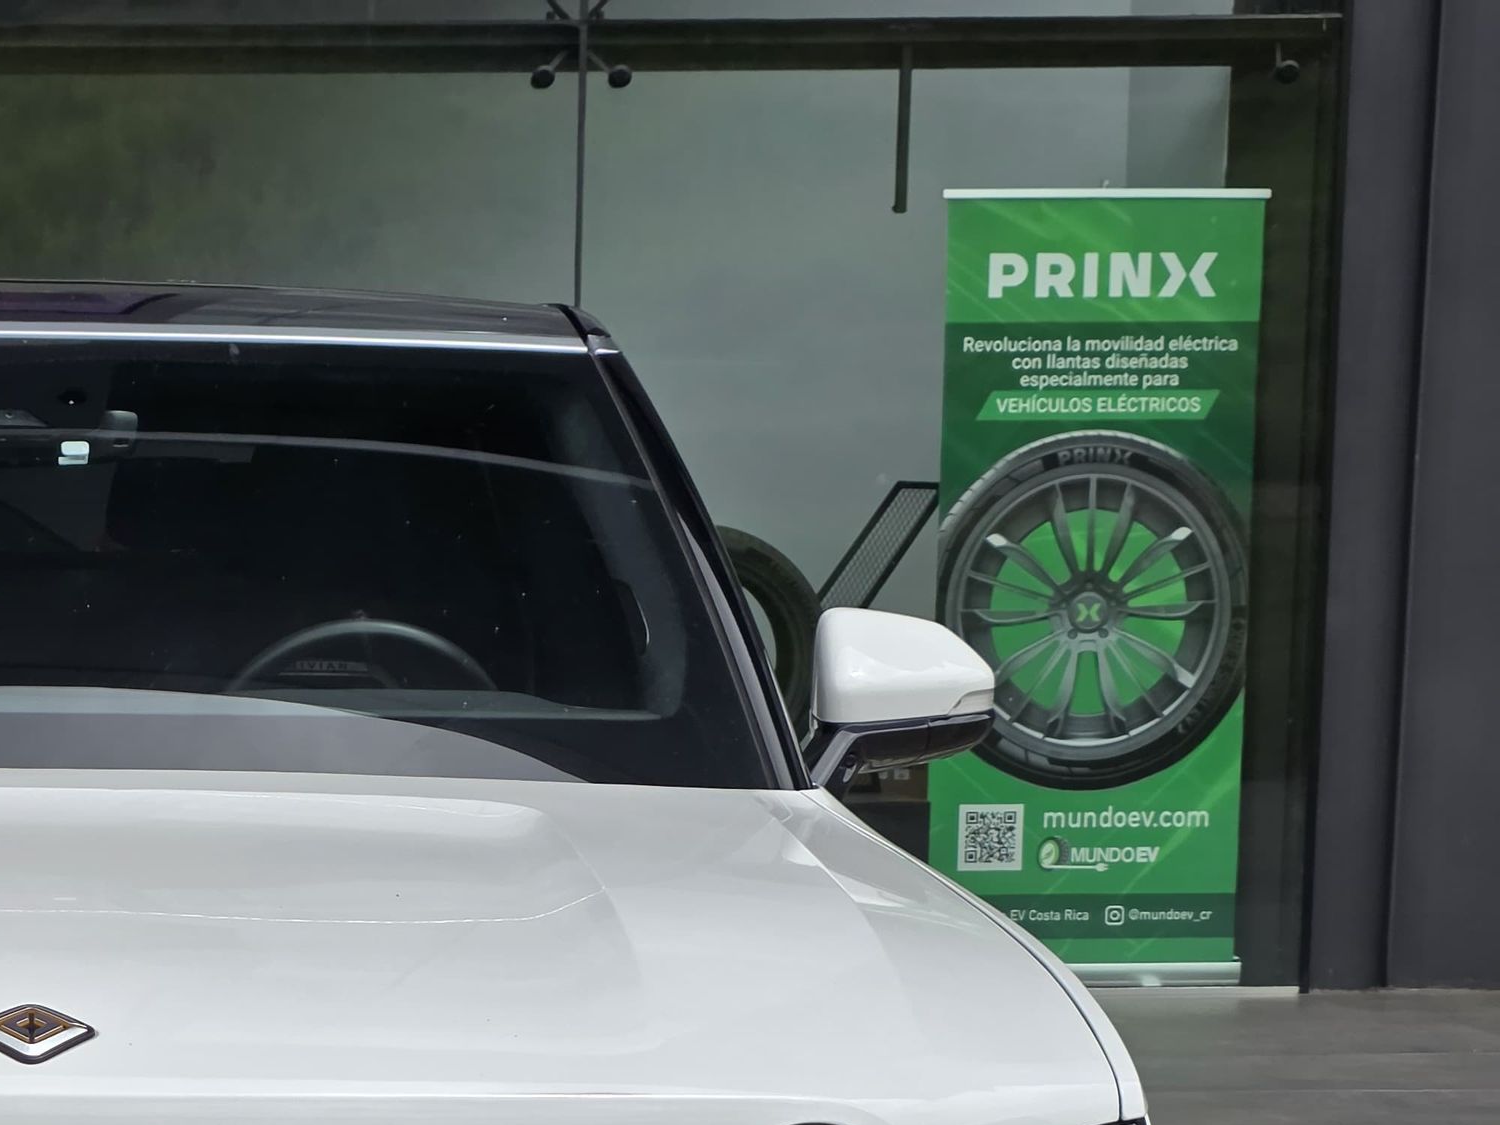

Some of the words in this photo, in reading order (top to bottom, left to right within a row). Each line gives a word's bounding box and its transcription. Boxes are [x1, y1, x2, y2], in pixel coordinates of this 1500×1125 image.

[988, 252, 1218, 298] PRINX
[963, 336, 1062, 352] Revoluciona
[1066, 335, 1081, 351] la
[1085, 335, 1165, 351] movilidad
[1168, 335, 1239, 351] eléctrica
[1011, 357, 1042, 369] con
[1046, 353, 1101, 369] llantas
[1105, 352, 1189, 369] diseñadas
[1019, 371, 1139, 390] especialmente
[1142, 374, 1180, 390] para
[996, 394, 1092, 413] VEHÍCULOS
[1096, 394, 1202, 413] ELÉCTRICOS
[1043, 805, 1209, 829] mundoev.com
[1070, 846, 1160, 863] MUNDOEV
[1010, 909, 1026, 921] EV
[1028, 909, 1061, 921] Costa
[1064, 909, 1090, 921] Rica
[1128, 908, 1213, 922] @mundoev_cr
